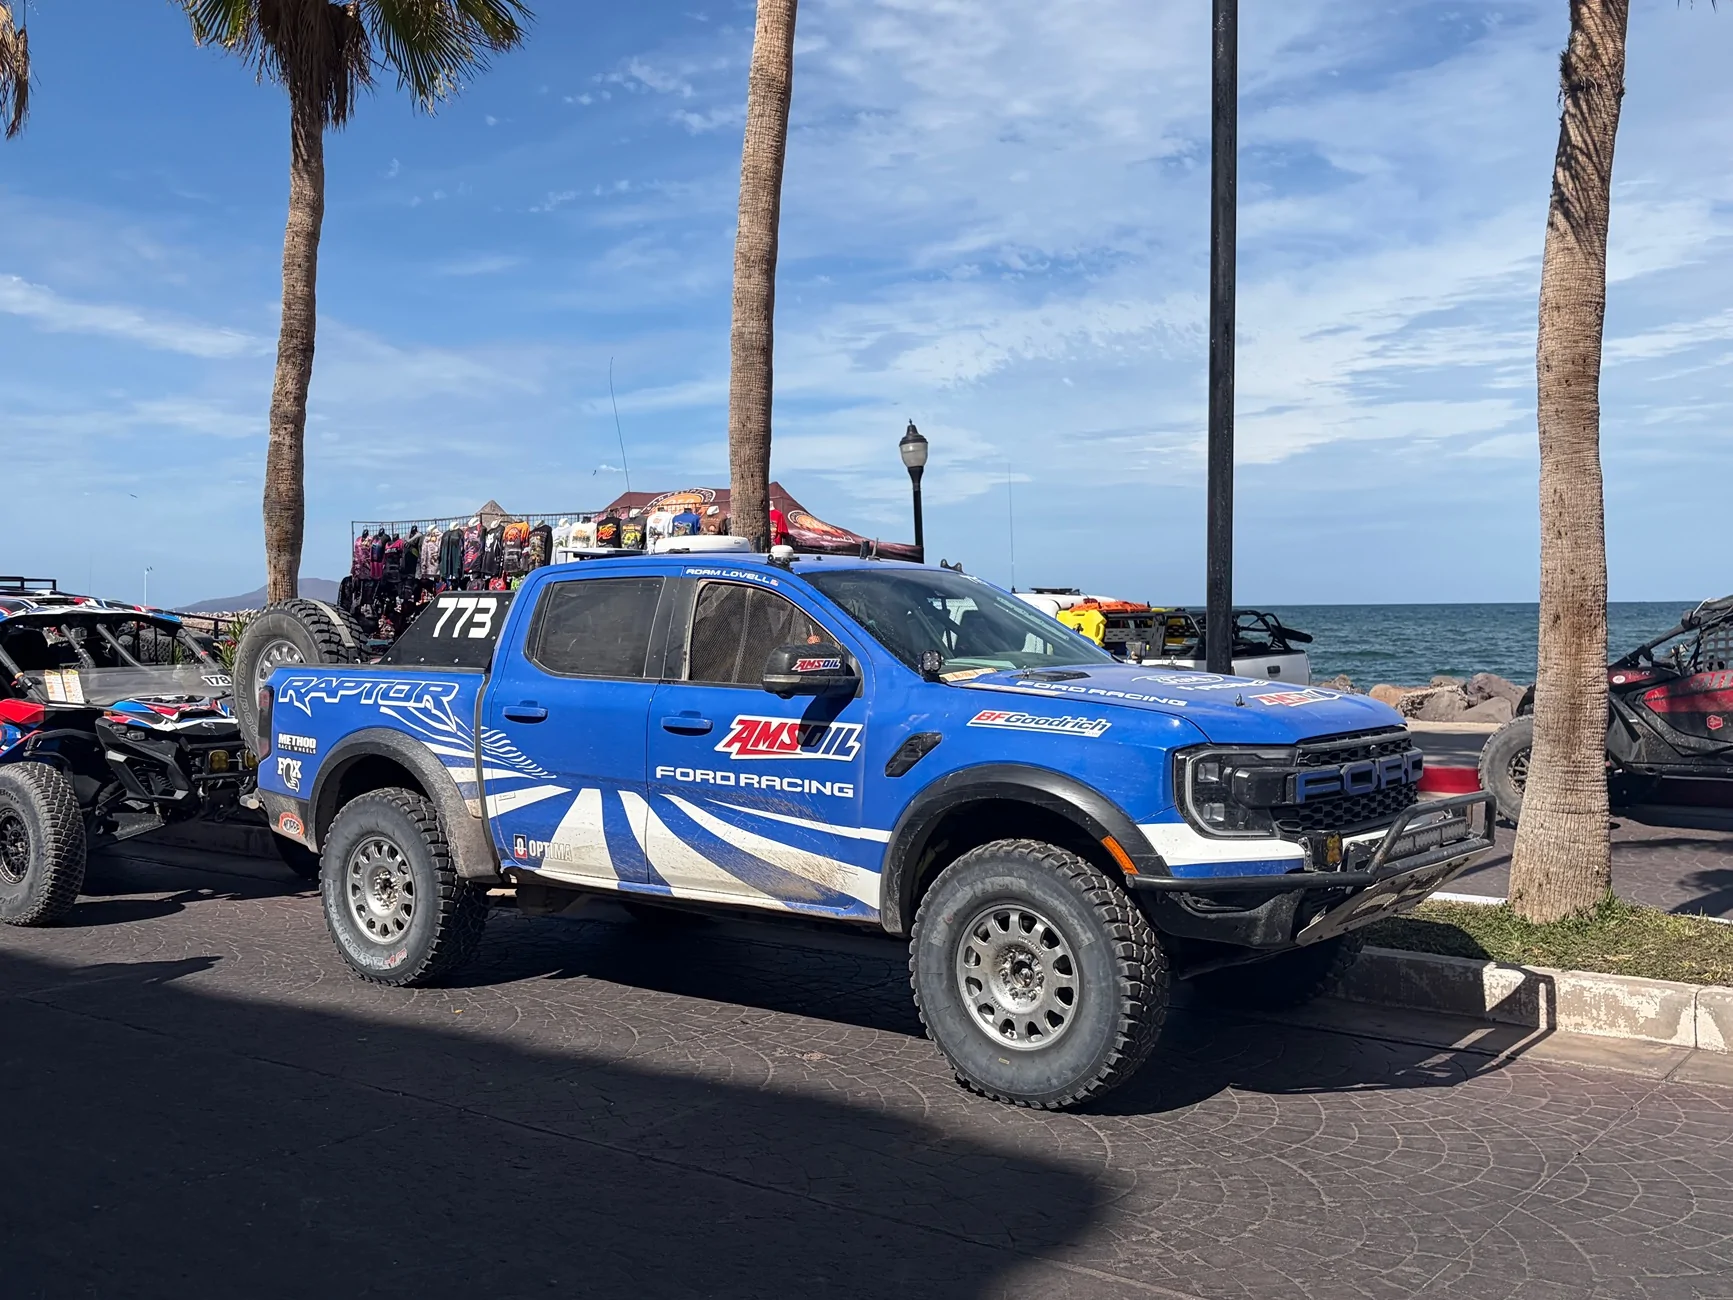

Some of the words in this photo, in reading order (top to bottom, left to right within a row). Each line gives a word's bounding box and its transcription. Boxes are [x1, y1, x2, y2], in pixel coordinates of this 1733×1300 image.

[685, 568, 721, 576] ADAM
[722, 570, 770, 584] LOVELL
[433, 597, 498, 638] 773
[793, 659, 840, 672] AMSOIL
[239, 647, 259, 737] oodrich
[278, 677, 459, 732] RAPTOR
[1016, 681, 1086, 693] FORD
[1087, 688, 1188, 707] RACING
[975, 711, 1108, 731] BFGoodrich
[278, 733, 316, 749] METHOD
[293, 746, 316, 754] WHEELS
[723, 719, 861, 757] AMSOIL
[277, 757, 302, 790] FOX
[656, 765, 736, 786] FORD
[739, 774, 854, 798] RACING
[1296, 747, 1424, 803] FORD
[528, 840, 573, 861] OPTIMA
